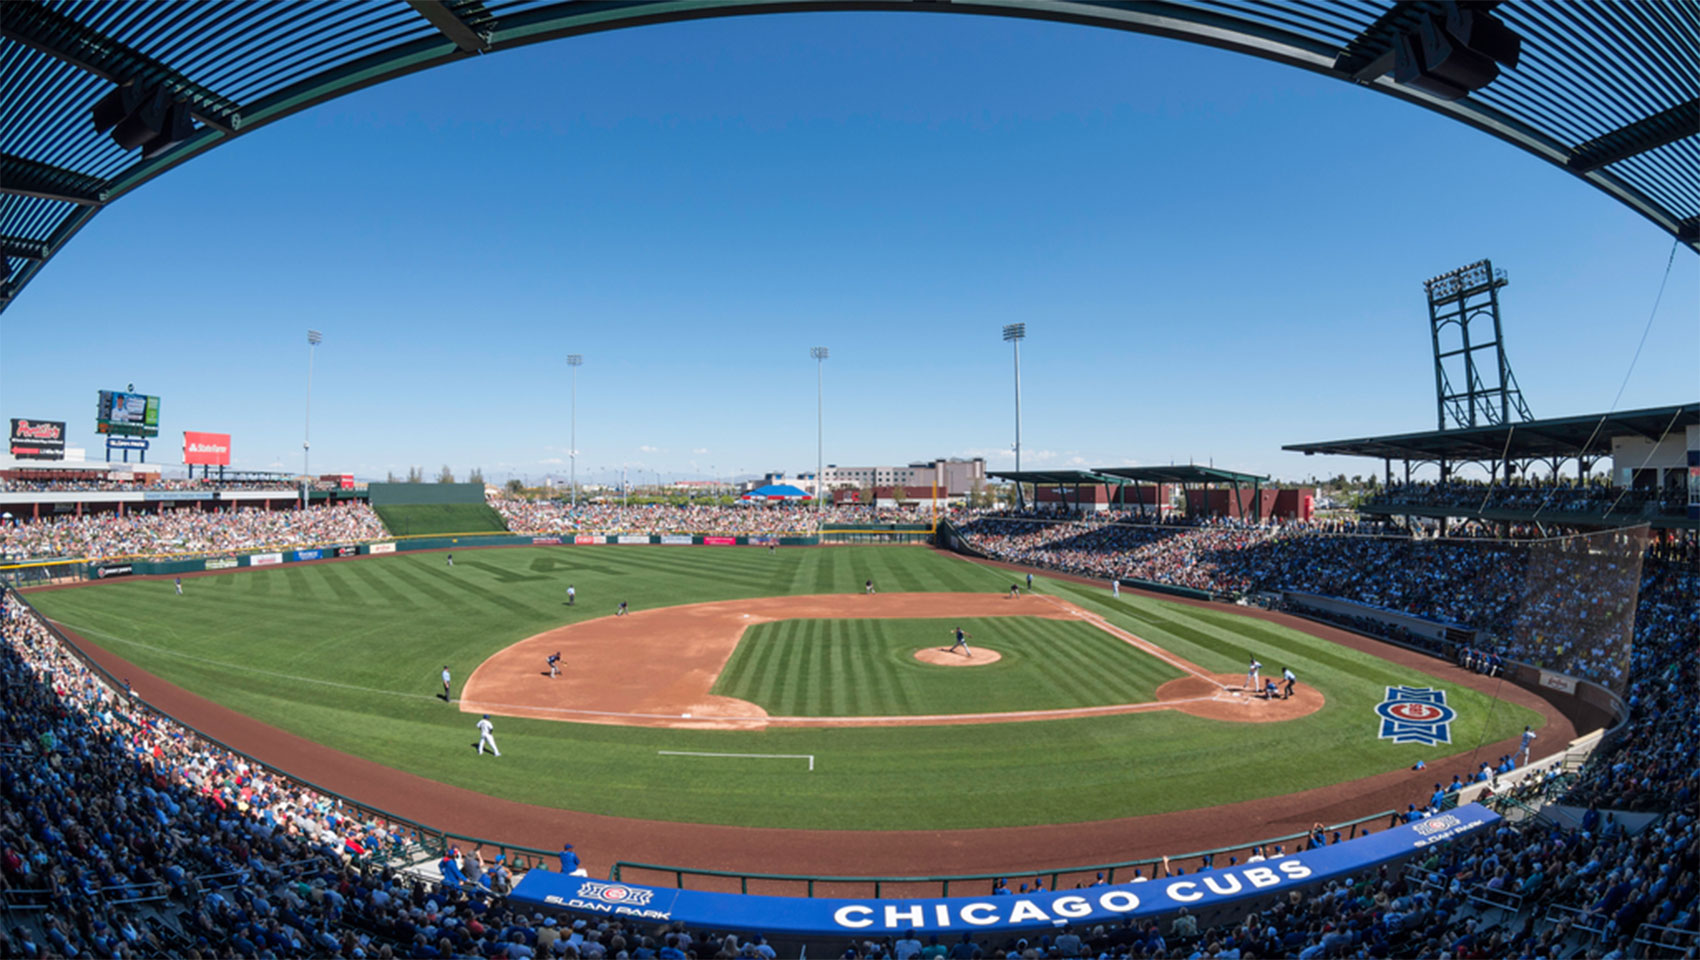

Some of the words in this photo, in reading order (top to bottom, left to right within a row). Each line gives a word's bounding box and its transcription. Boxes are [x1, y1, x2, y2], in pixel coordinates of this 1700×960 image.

[544, 894, 612, 912] SLOAN
[615, 906, 671, 920] PARK
[834, 890, 1141, 928] CHICAGO
[1166, 860, 1313, 902] CUBS
